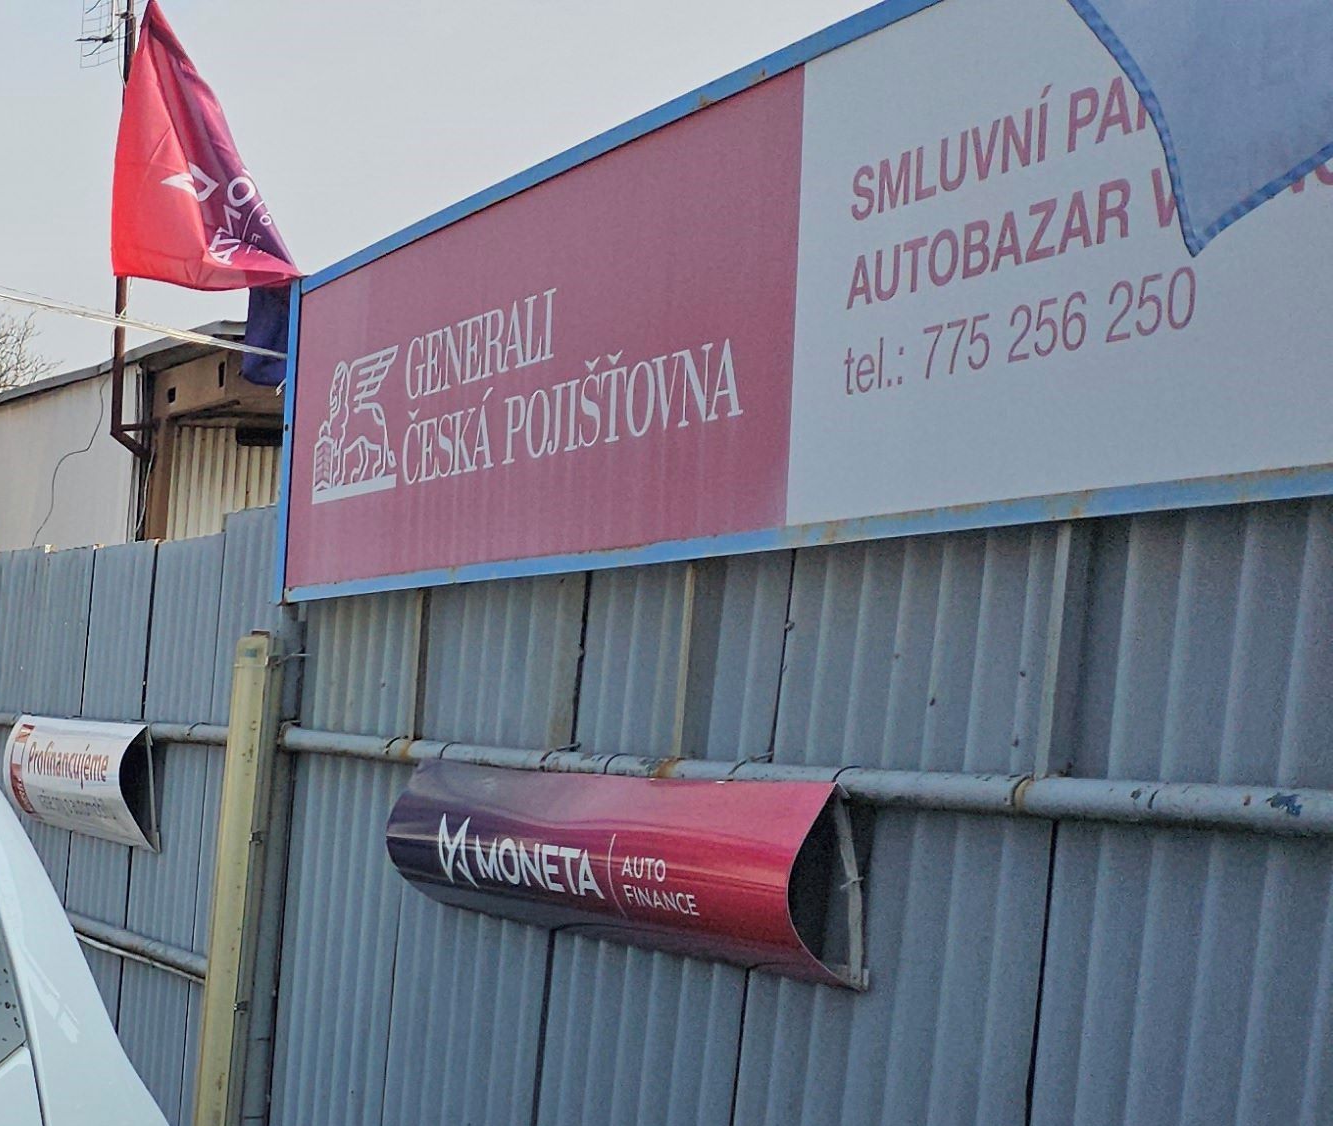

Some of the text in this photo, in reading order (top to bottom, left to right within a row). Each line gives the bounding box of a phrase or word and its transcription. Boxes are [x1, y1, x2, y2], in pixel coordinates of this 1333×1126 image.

[850, 84, 1053, 221] SMLUVNÍ
[846, 178, 1131, 309] AUTOBAZAR
[405, 287, 557, 400] GENERALI
[844, 266, 1197, 395] tel.: 775 256 250
[401, 338, 744, 486] ČESKÁ POJIŠŤOVNA
[475, 834, 605, 900] MONETA
[621, 856, 667, 883] AUTO
[624, 885, 700, 917] FINANCE
